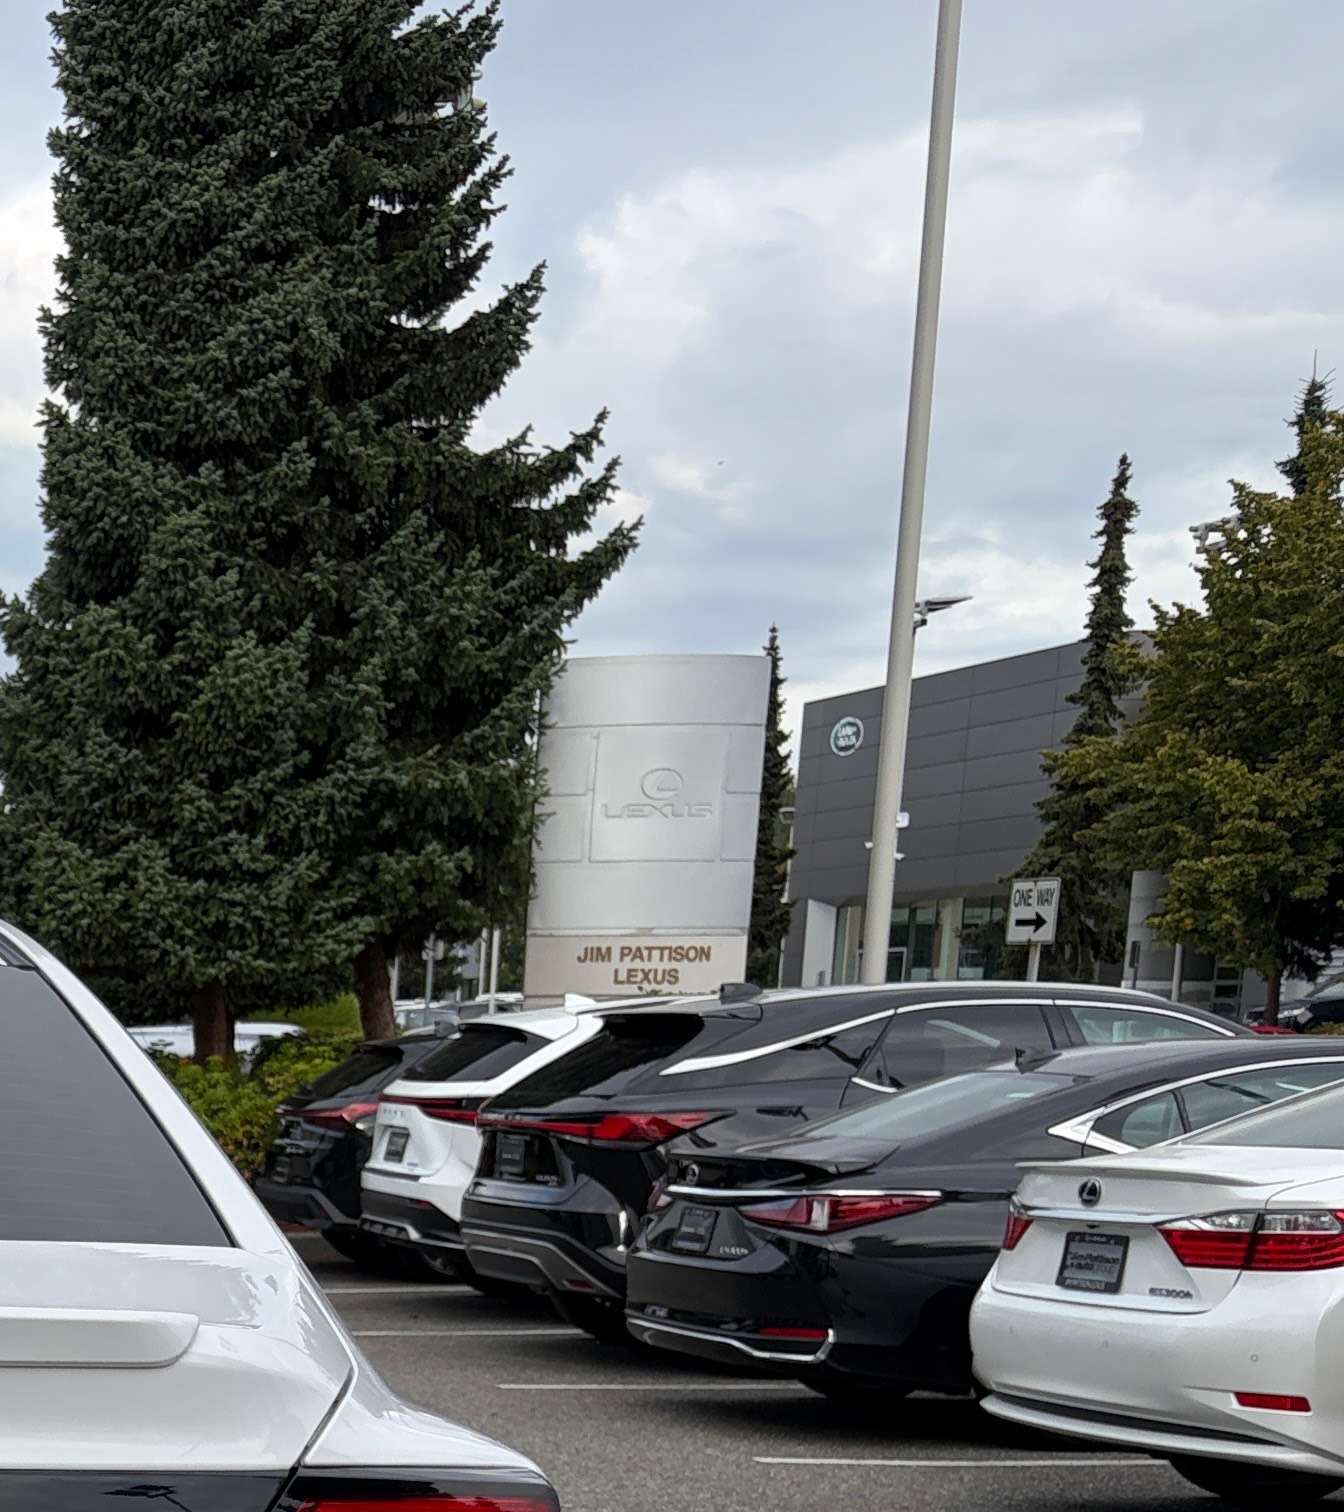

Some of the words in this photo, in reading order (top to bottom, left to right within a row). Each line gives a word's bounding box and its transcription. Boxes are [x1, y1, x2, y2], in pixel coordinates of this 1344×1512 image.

[601, 802, 713, 819] LEXUS
[1014, 888, 1033, 908] ONE
[1037, 887, 1056, 907] WAY
[576, 946, 612, 964] JIM
[619, 945, 712, 963] PATTISON
[613, 968, 680, 986] LEXUS
